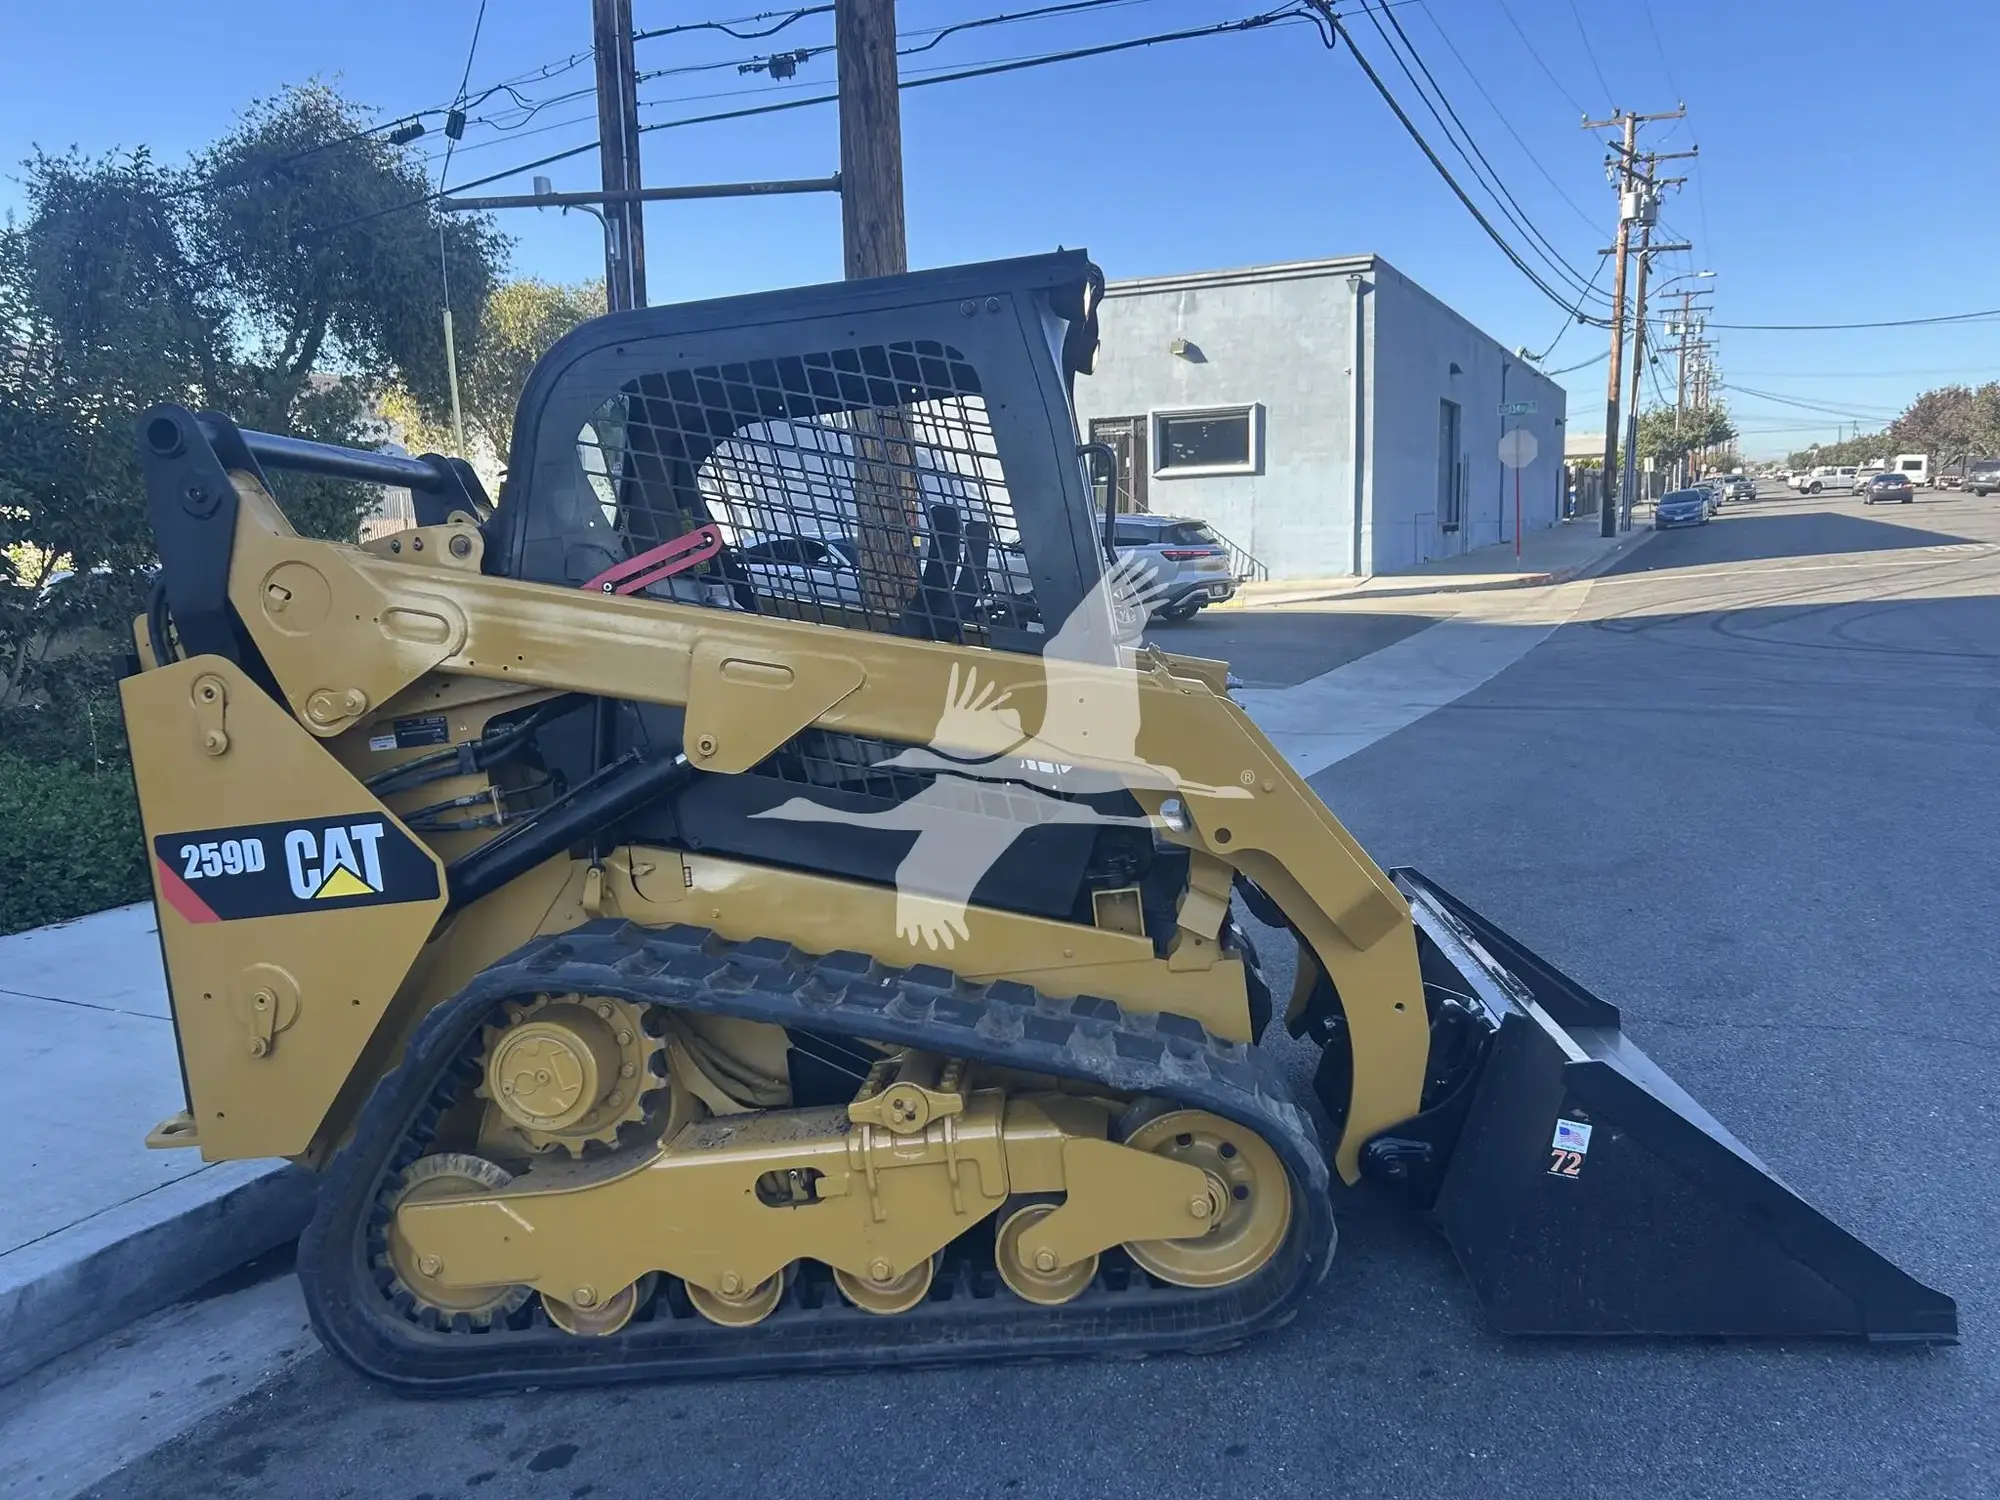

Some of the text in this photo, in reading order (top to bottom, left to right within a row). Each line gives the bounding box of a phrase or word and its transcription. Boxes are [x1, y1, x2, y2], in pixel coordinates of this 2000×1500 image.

[180, 822, 385, 900] 259D CAT
[1550, 1148, 1582, 1175] 72
